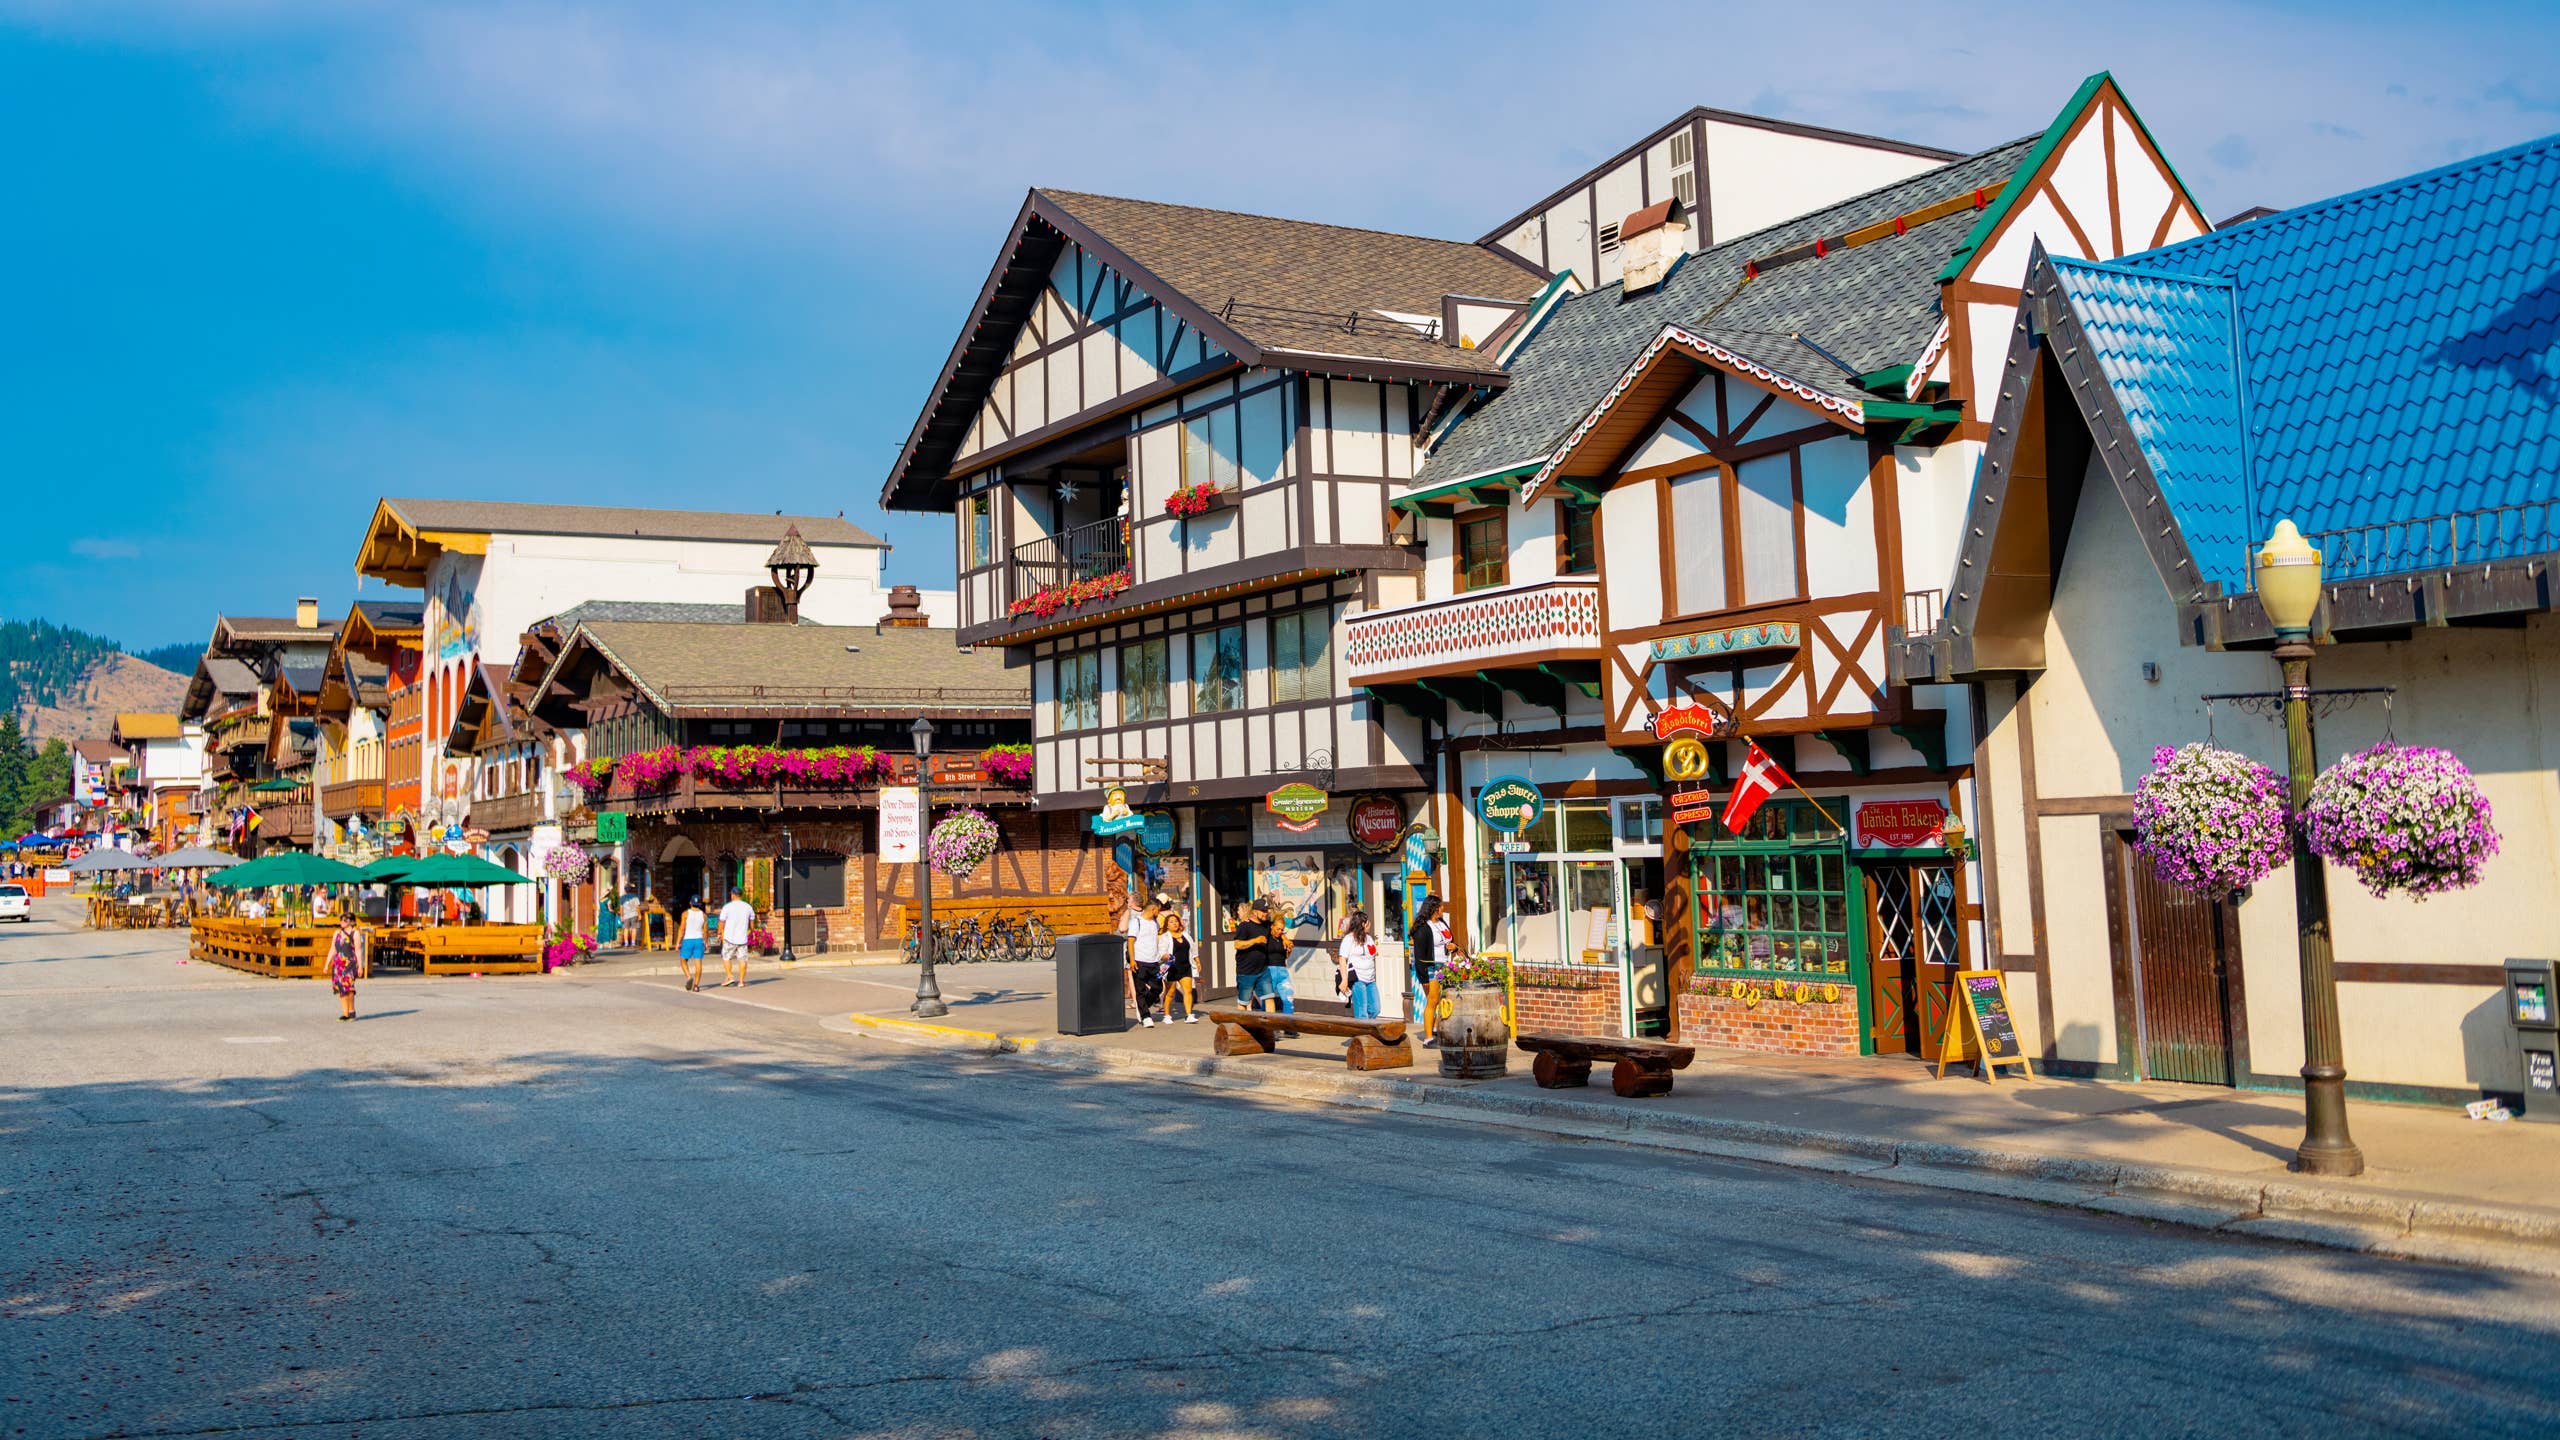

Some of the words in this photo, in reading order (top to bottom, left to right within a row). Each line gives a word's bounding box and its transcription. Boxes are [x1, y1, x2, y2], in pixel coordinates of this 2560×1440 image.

[944, 773, 956, 781] 8th
[957, 772, 977, 781] Street
[1484, 788, 1507, 805] Das
[1508, 784, 1537, 804] Sweet
[1367, 806, 1396, 817] Historical
[1486, 806, 1519, 819] Shoppe
[1676, 809, 1709, 821] ESPRESSO
[1870, 806, 1880, 814] The
[887, 814, 913, 825] Shopping
[1863, 808, 1898, 828] Danish
[1901, 806, 1940, 828] Bakery
[1355, 815, 1397, 834] Museum
[68, 849, 82, 857] STOP
[2531, 1053, 2551, 1065] Free
[2530, 1065, 2554, 1077] Local
[2533, 1076, 2552, 1090] Map
